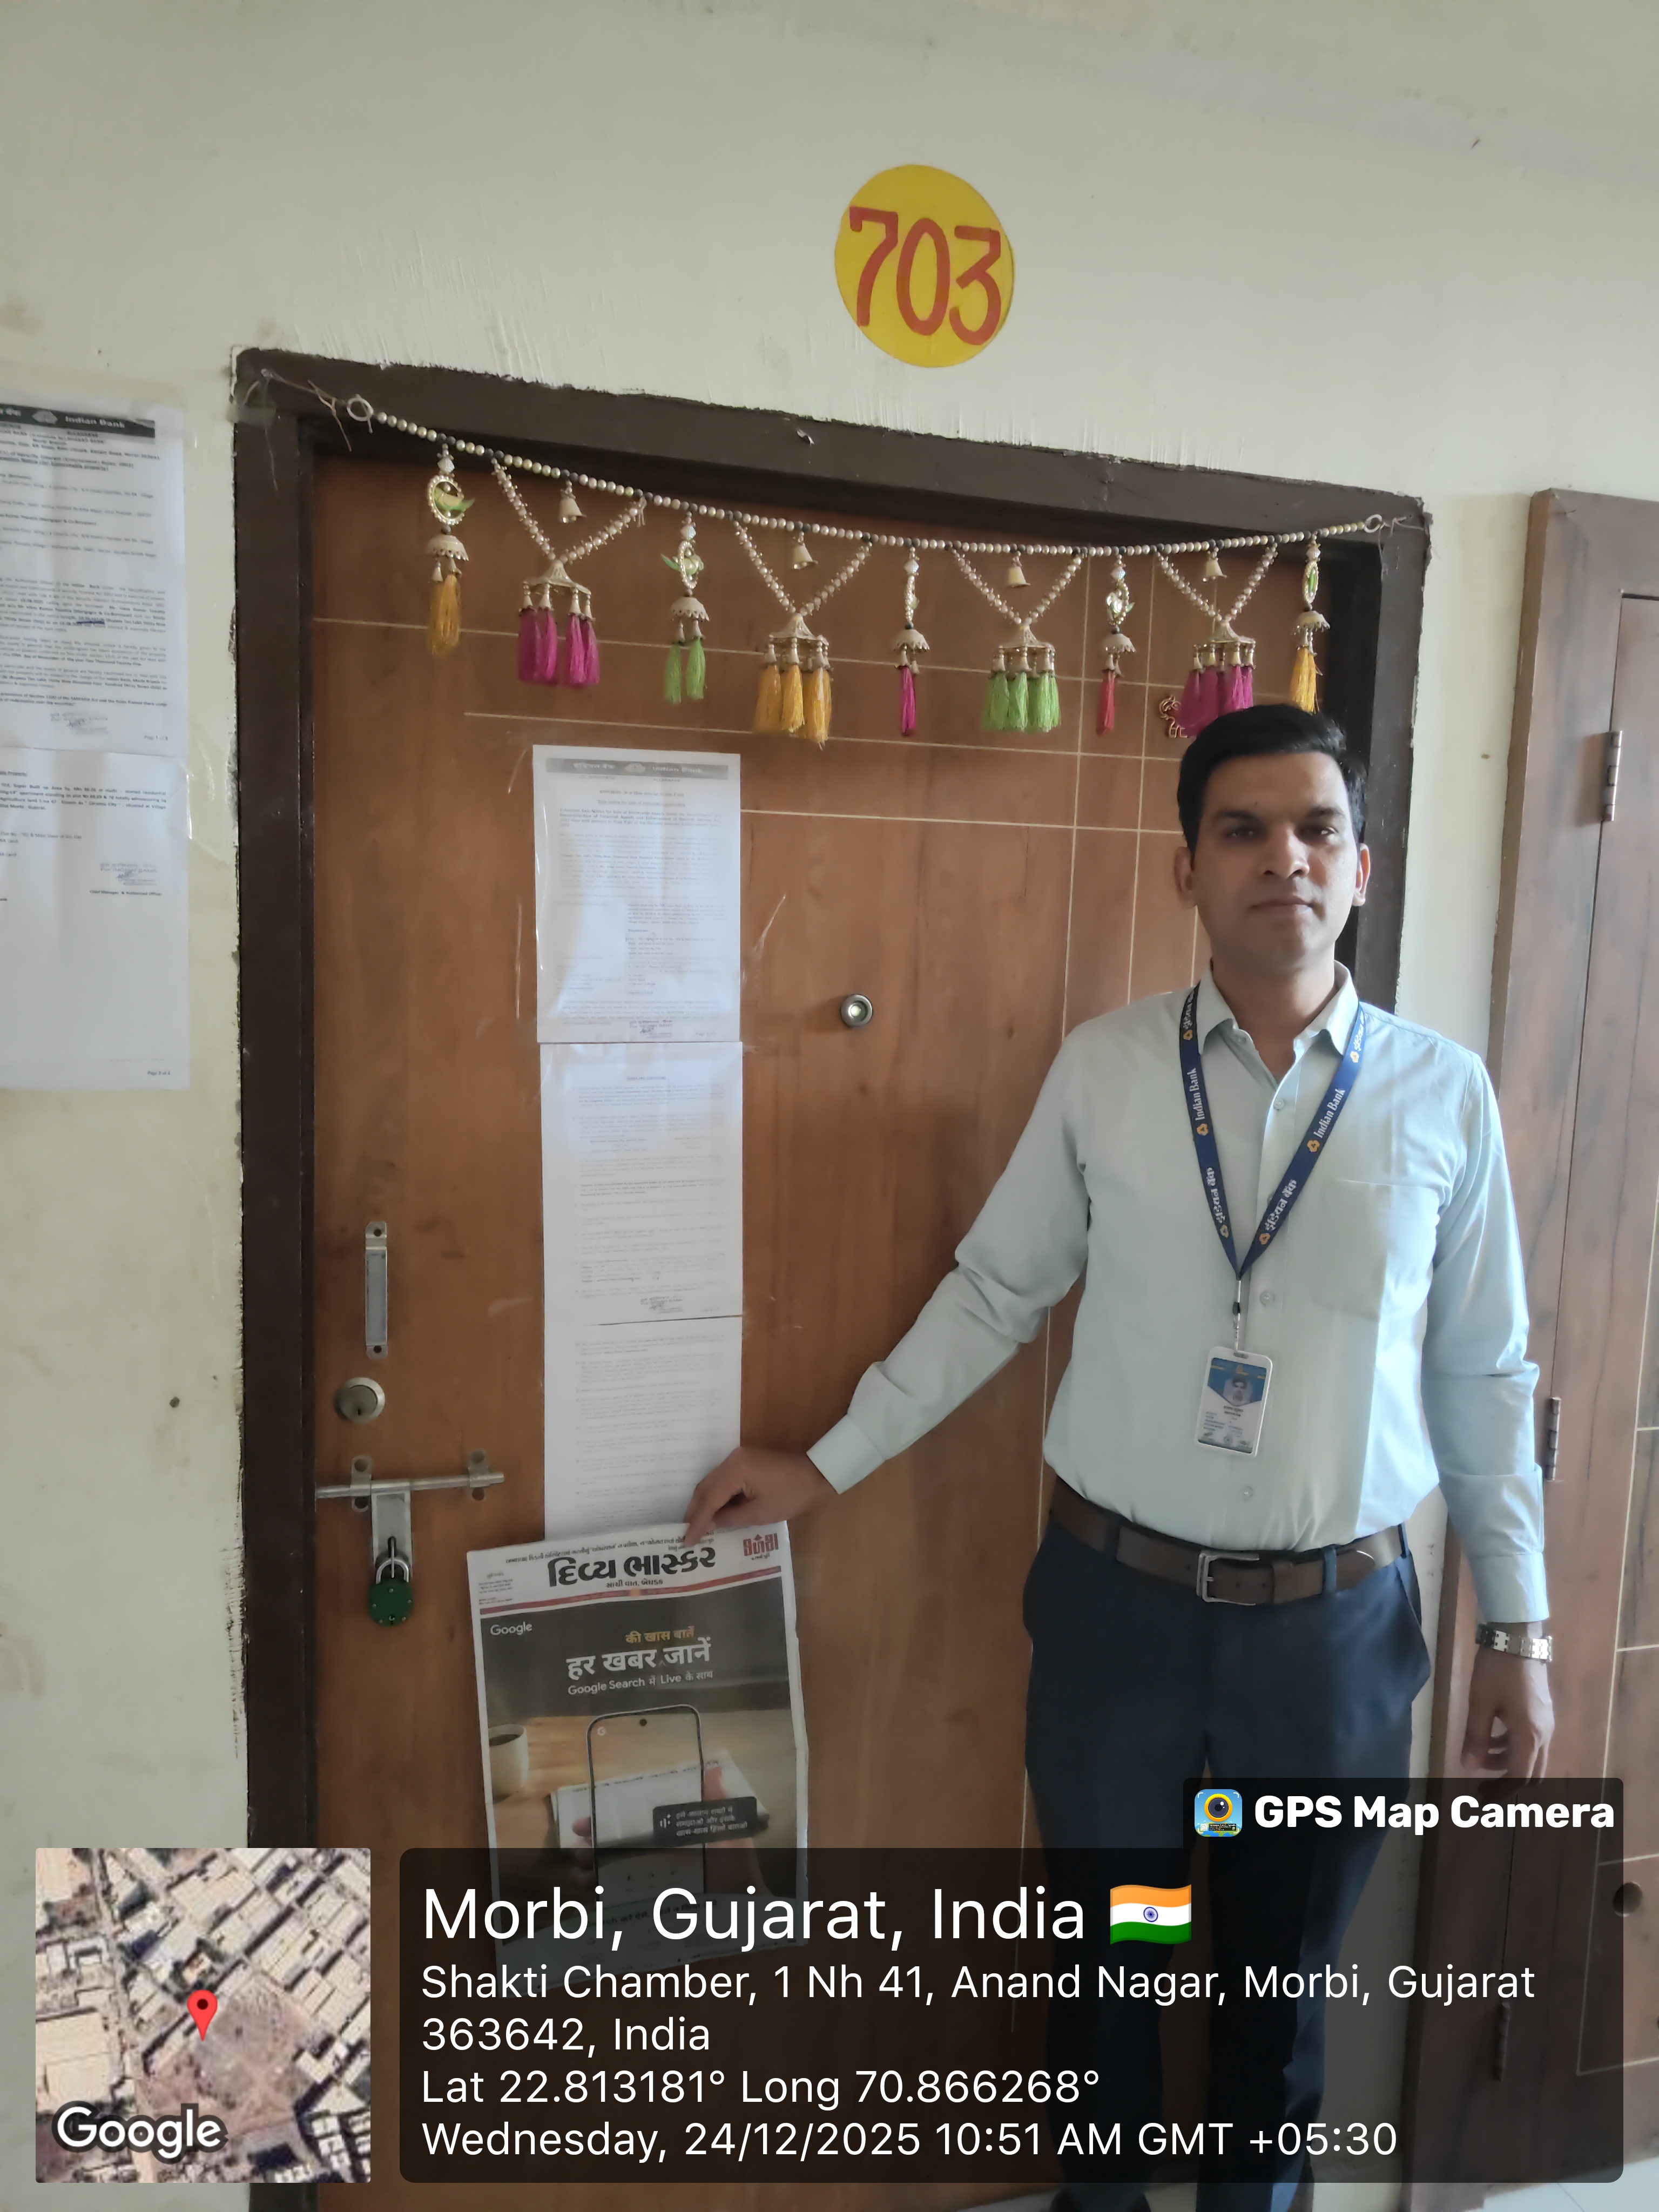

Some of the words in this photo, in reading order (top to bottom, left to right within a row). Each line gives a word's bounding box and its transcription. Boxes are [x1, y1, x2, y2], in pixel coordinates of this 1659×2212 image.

[849, 205, 1001, 346] 703
[65, 415, 97, 425] Indian
[99, 419, 125, 428] Bank
[1187, 1067, 1200, 1092] Bank
[1193, 1092, 1205, 1121] Indian
[1313, 1110, 1334, 1138] Indian
[1327, 1088, 1345, 1111] Bank
[547, 1557, 616, 1587] દિવ્ય
[624, 1547, 716, 1577] ભાસ્કર
[490, 1621, 532, 1636] Google
[625, 1630, 642, 1643] की
[644, 1630, 671, 1642] खास
[566, 1655, 596, 1681] हर
[602, 1649, 658, 1671] खबर
[662, 1636, 711, 1664] जानें
[568, 1682, 606, 1695] Google
[609, 1677, 645, 1690] Search
[660, 1674, 682, 1684] Live
